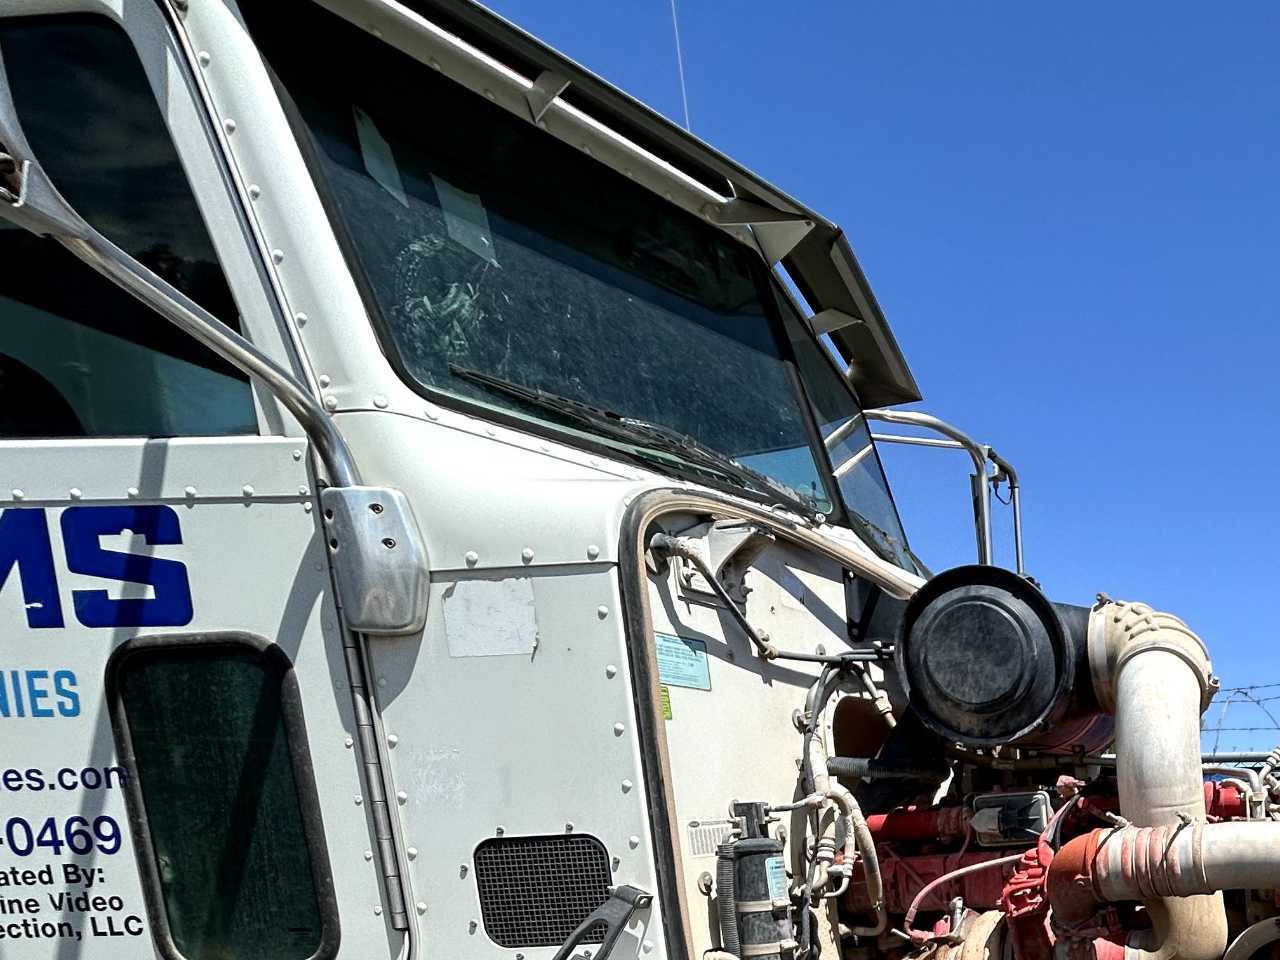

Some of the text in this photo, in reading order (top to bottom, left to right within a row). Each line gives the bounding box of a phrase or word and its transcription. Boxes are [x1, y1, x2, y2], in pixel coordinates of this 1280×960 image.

[0, 767, 129, 792] es.com
[0, 815, 122, 857] 0469
[62, 863, 105, 888] By:
[48, 891, 124, 913] Video
[90, 915, 144, 938] LLC
